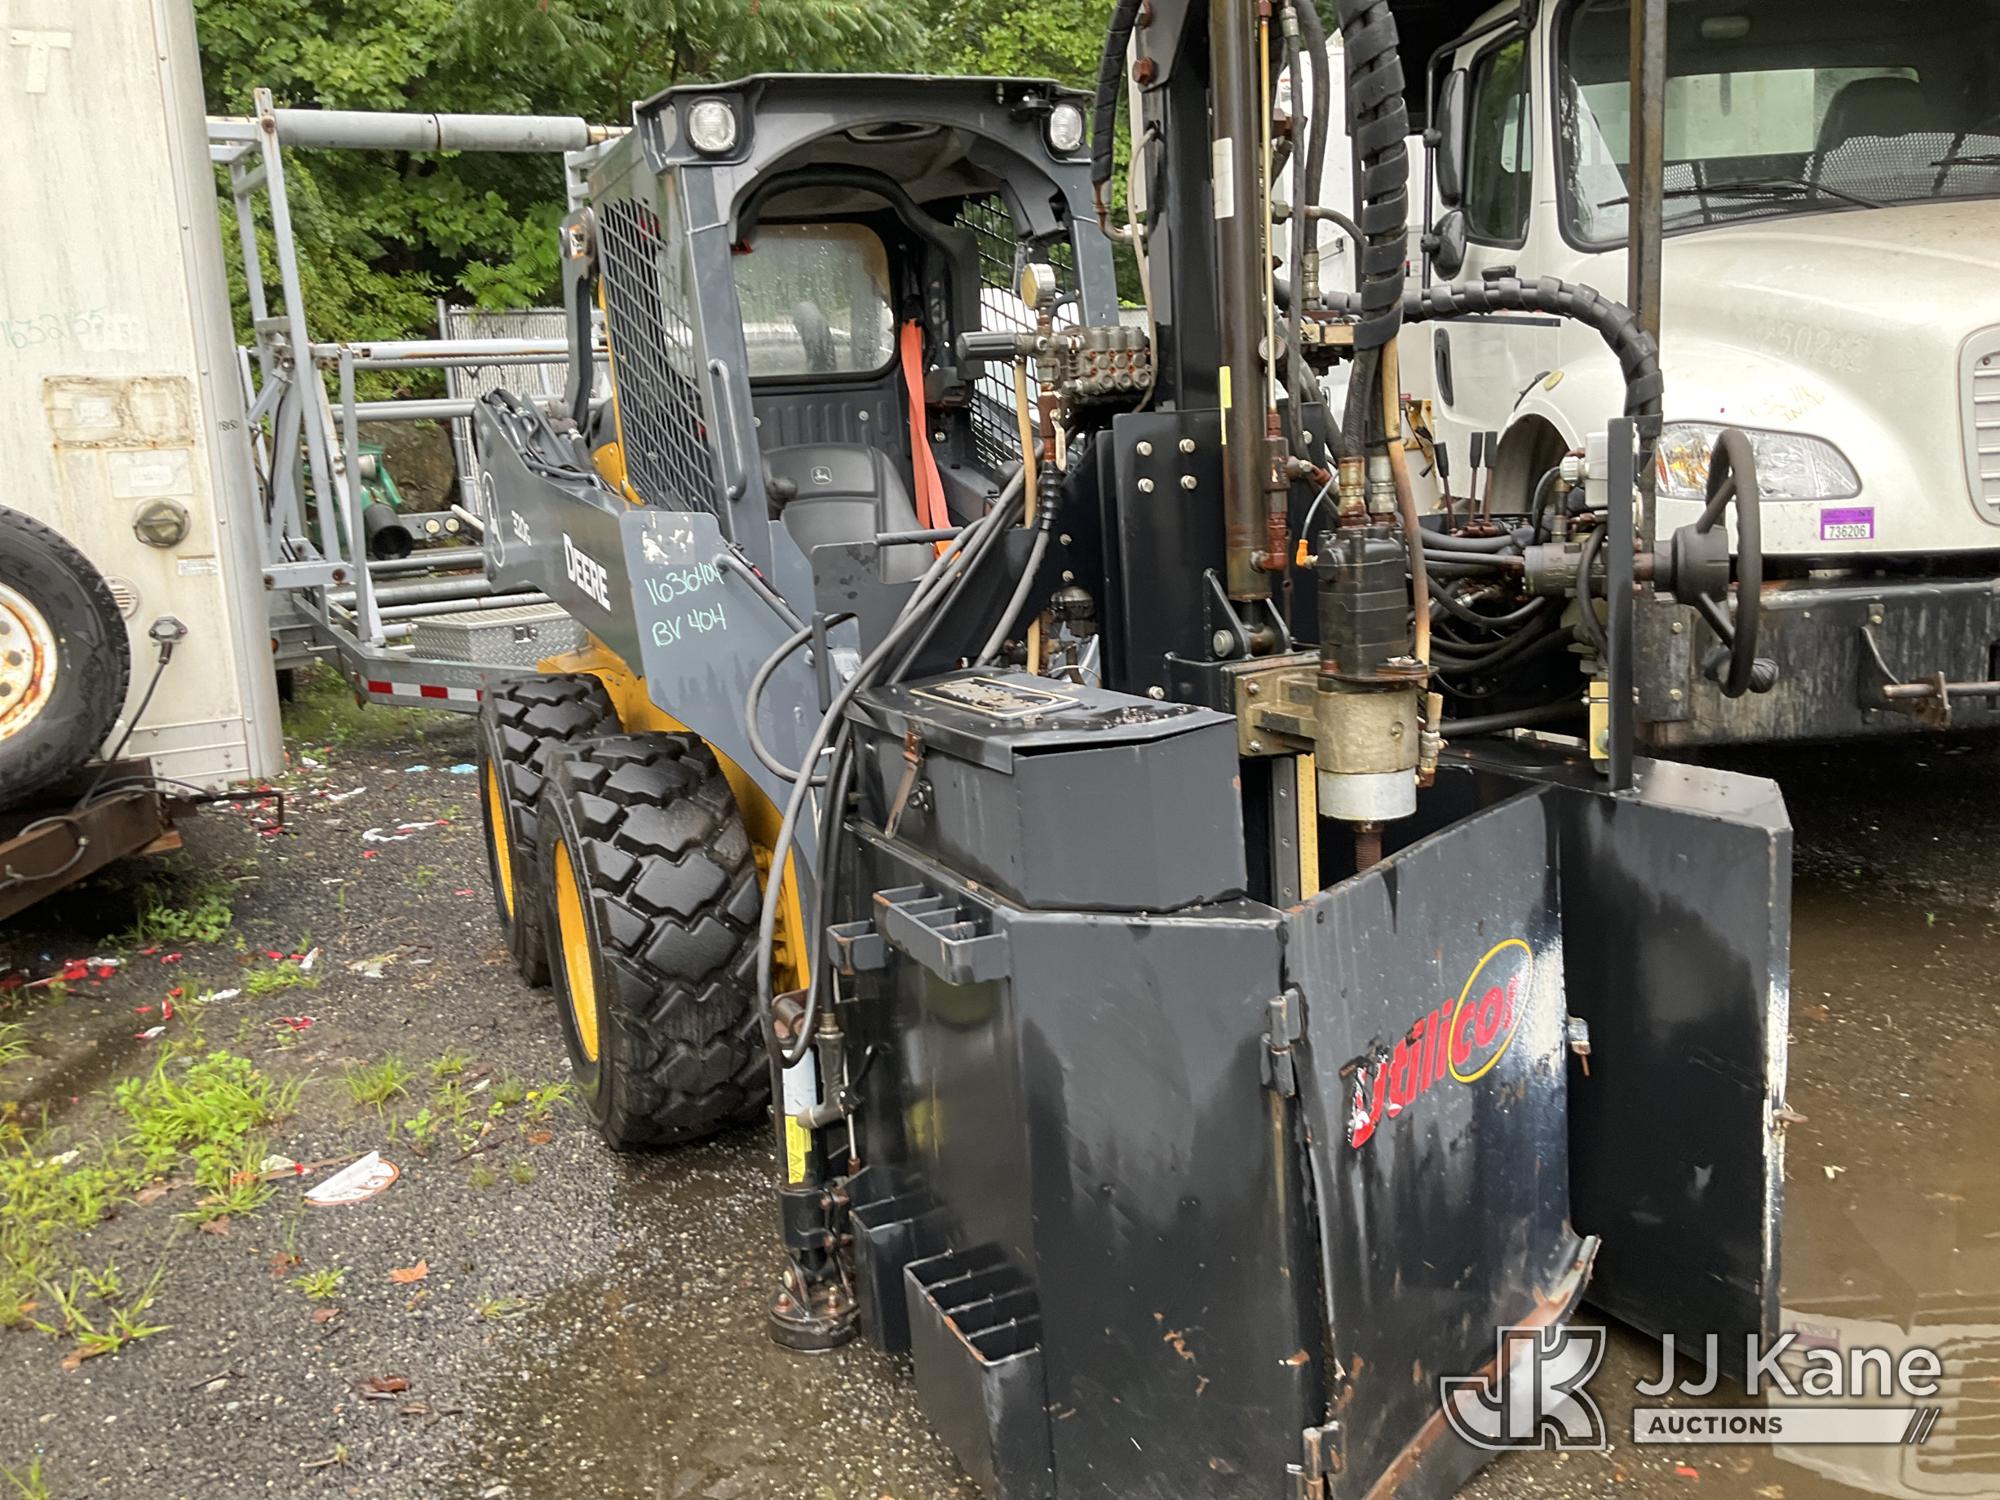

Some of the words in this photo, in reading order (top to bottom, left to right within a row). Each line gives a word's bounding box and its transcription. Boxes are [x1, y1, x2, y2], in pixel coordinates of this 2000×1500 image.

[1829, 524, 1867, 538] 736206
[562, 531, 612, 611] DEERE
[652, 616, 681, 647] BV
[687, 602, 727, 634] 404
